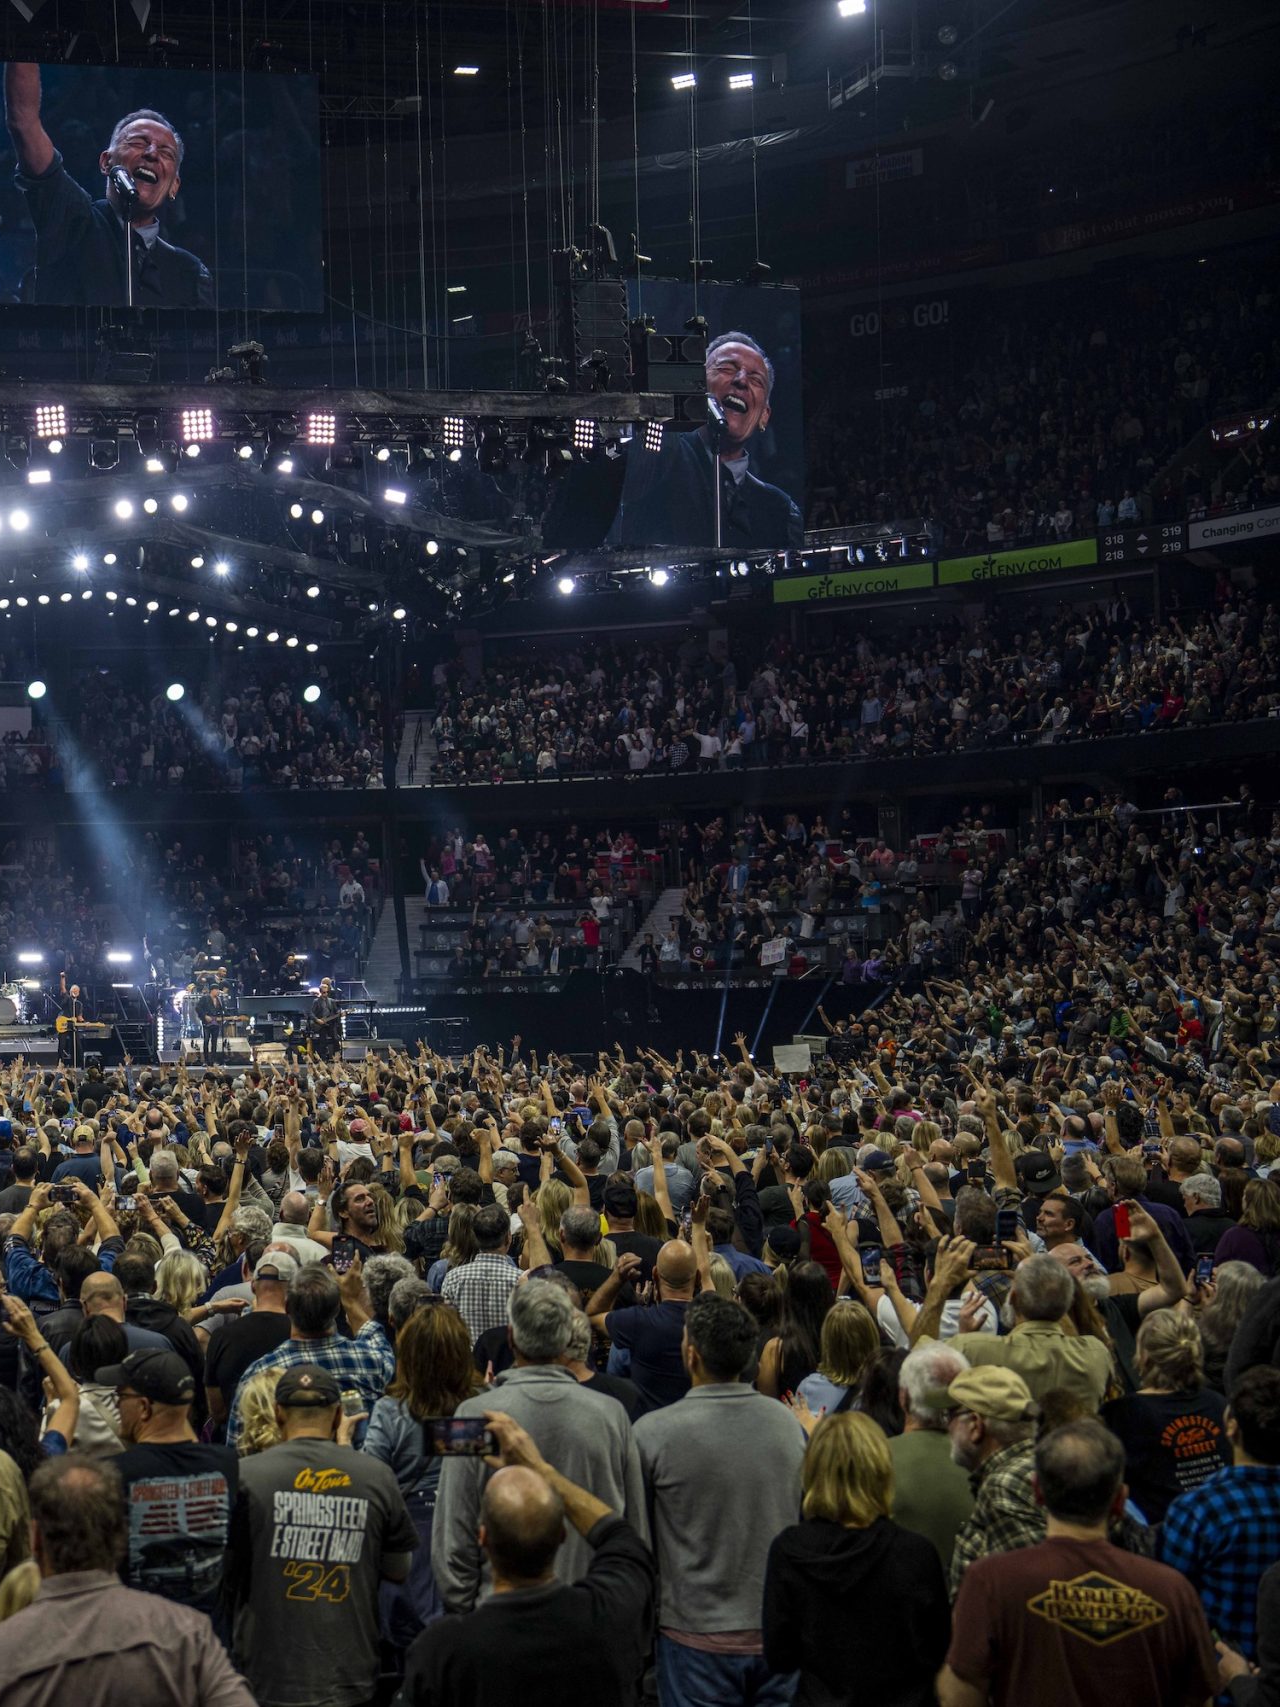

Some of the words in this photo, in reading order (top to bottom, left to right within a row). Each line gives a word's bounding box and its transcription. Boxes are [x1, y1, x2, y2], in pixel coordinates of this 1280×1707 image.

[1101, 214, 1138, 234] what
[1145, 204, 1193, 225] moves
[850, 312, 880, 337] GO
[913, 301, 949, 327] GO!
[1105, 535, 1124, 546] 318
[1162, 526, 1181, 537] 319
[1202, 522, 1254, 538] Changing
[1105, 551, 1124, 562] 218
[1162, 542, 1181, 553] 219
[808, 576, 898, 599] GFLENV.COM
[1160, 1415, 1221, 1447] SPRINGSTEEN
[1182, 1439, 1216, 1457] STREET
[294, 1467, 317, 1489] On
[312, 1468, 352, 1492] Tour
[274, 1491, 369, 1530] SPRINGSTEEN
[270, 1525, 283, 1557] E
[280, 1526, 332, 1560] STREET
[328, 1530, 365, 1562] BAND
[283, 1561, 350, 1602] '24
[1044, 1600, 1157, 1622] DAVIDSON
